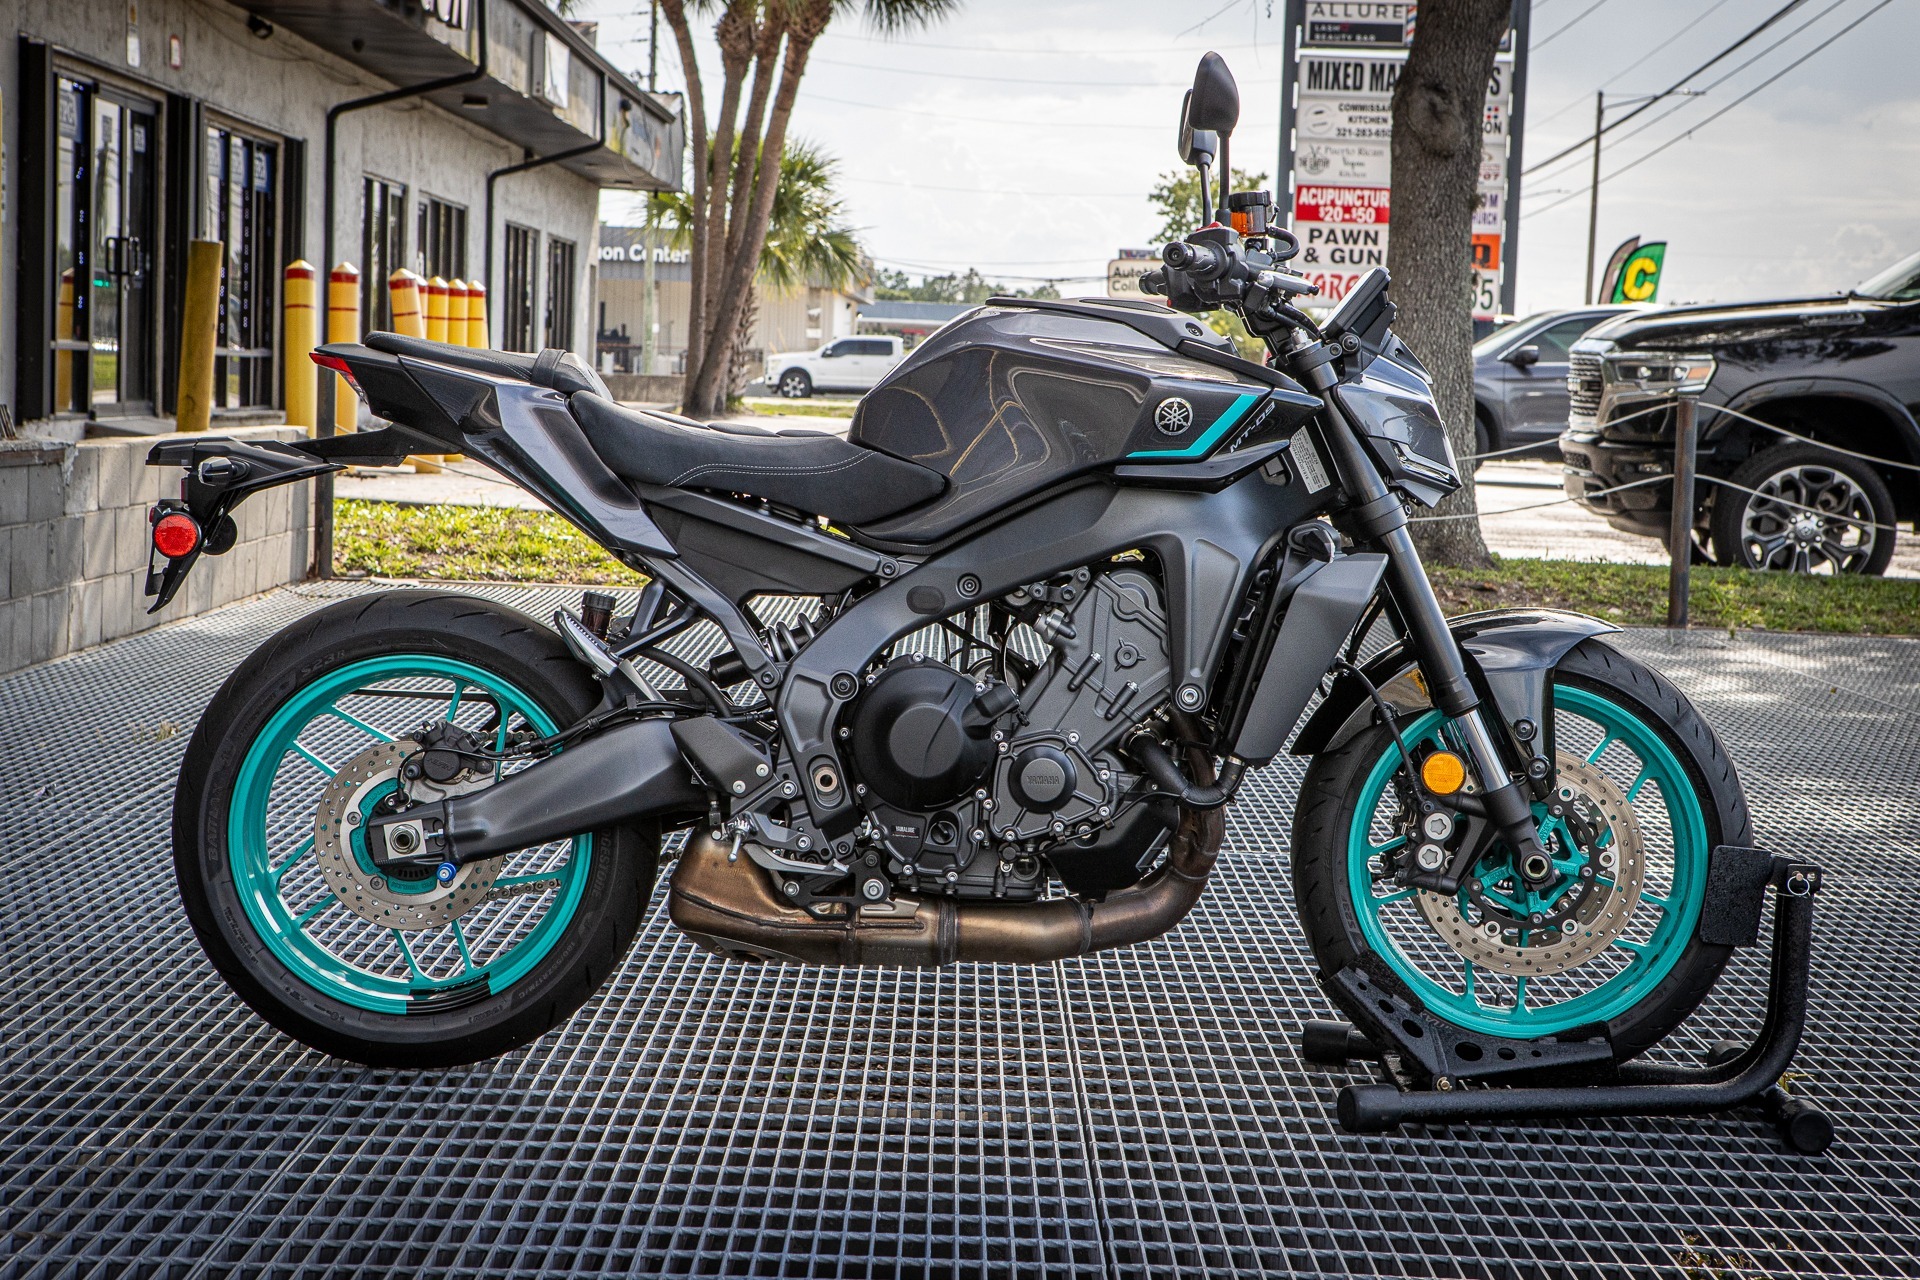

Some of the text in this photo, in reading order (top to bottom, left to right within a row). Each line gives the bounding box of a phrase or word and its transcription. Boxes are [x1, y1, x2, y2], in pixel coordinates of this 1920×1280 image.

[1312, 3, 1403, 18] ALLURE
[1308, 61, 1405, 92] MIXED MA
[1298, 187, 1390, 208] ACUPUNCTUR
[1309, 229, 1379, 246] PAWN
[1304, 247, 1382, 265] & GUN
[1112, 280, 1139, 291] Coll
[1623, 256, 1658, 301] C
[1230, 401, 1275, 453] MT-09
[1027, 775, 1060, 785] YAMAHA
